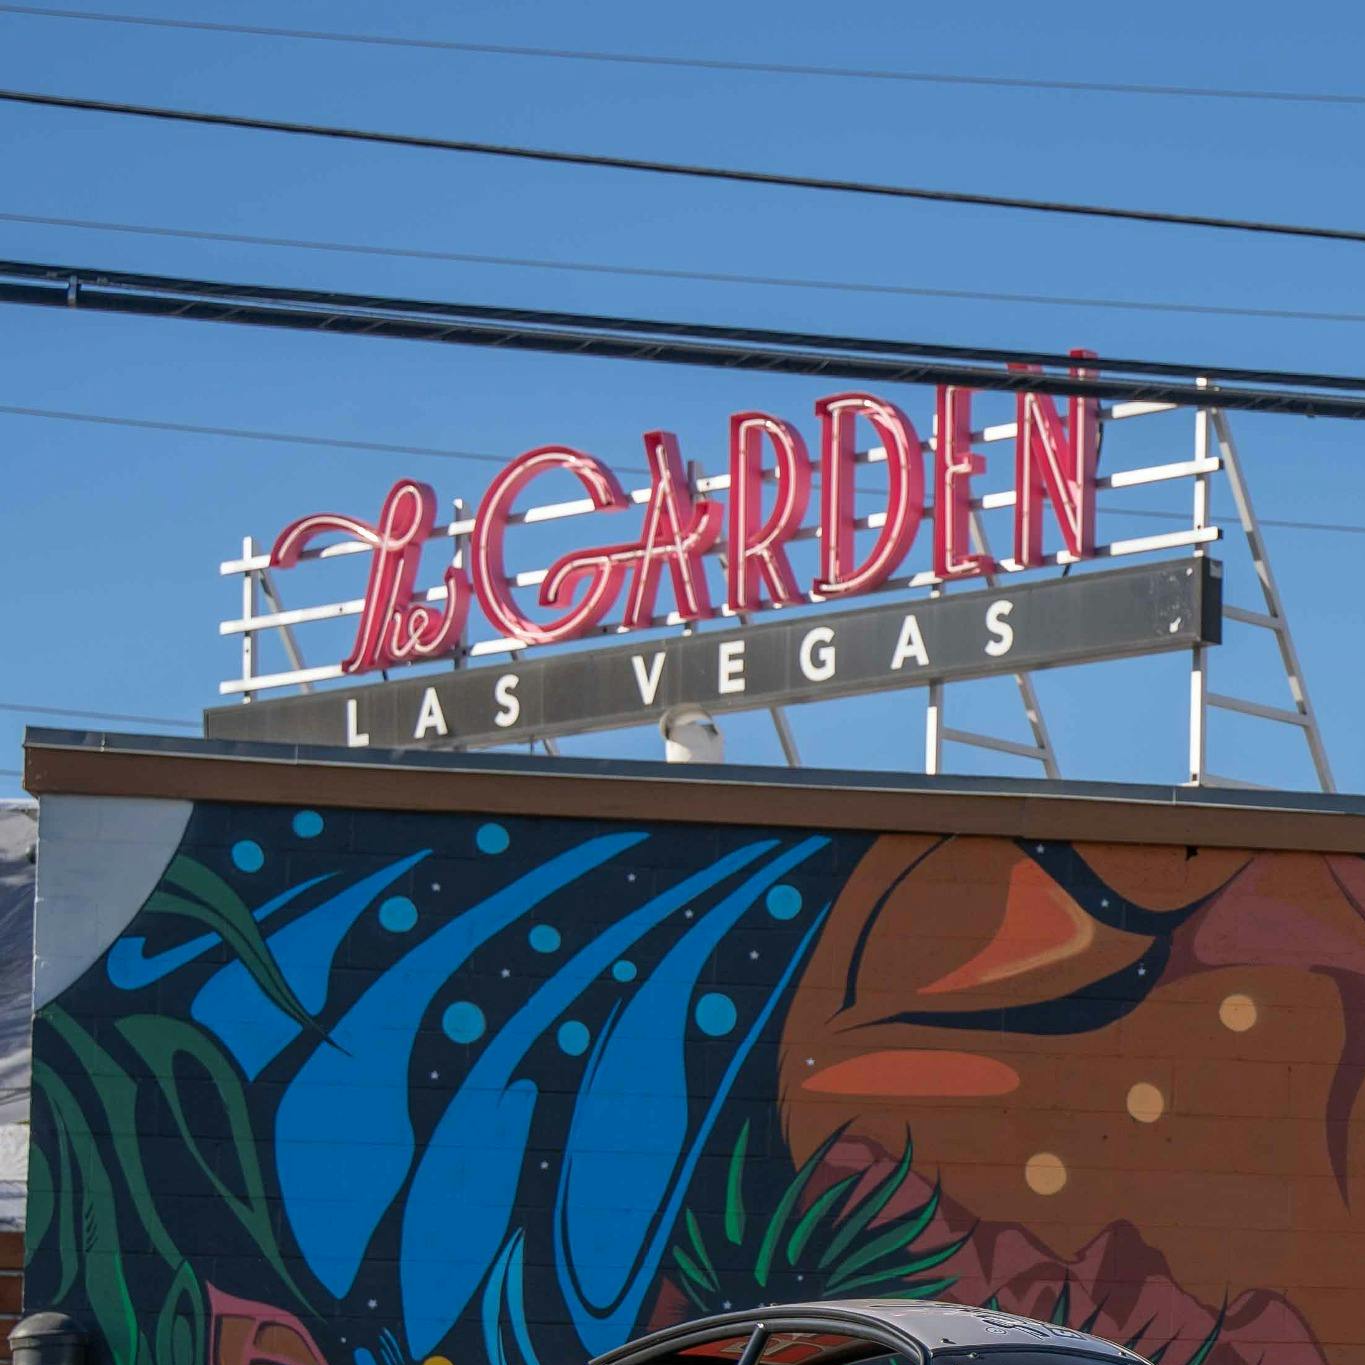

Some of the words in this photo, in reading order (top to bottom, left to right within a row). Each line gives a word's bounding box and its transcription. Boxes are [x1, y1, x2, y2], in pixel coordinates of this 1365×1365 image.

[470, 348, 1100, 645] GARDEN
[346, 672, 519, 748] LAS
[632, 599, 1014, 705] VEGAS
